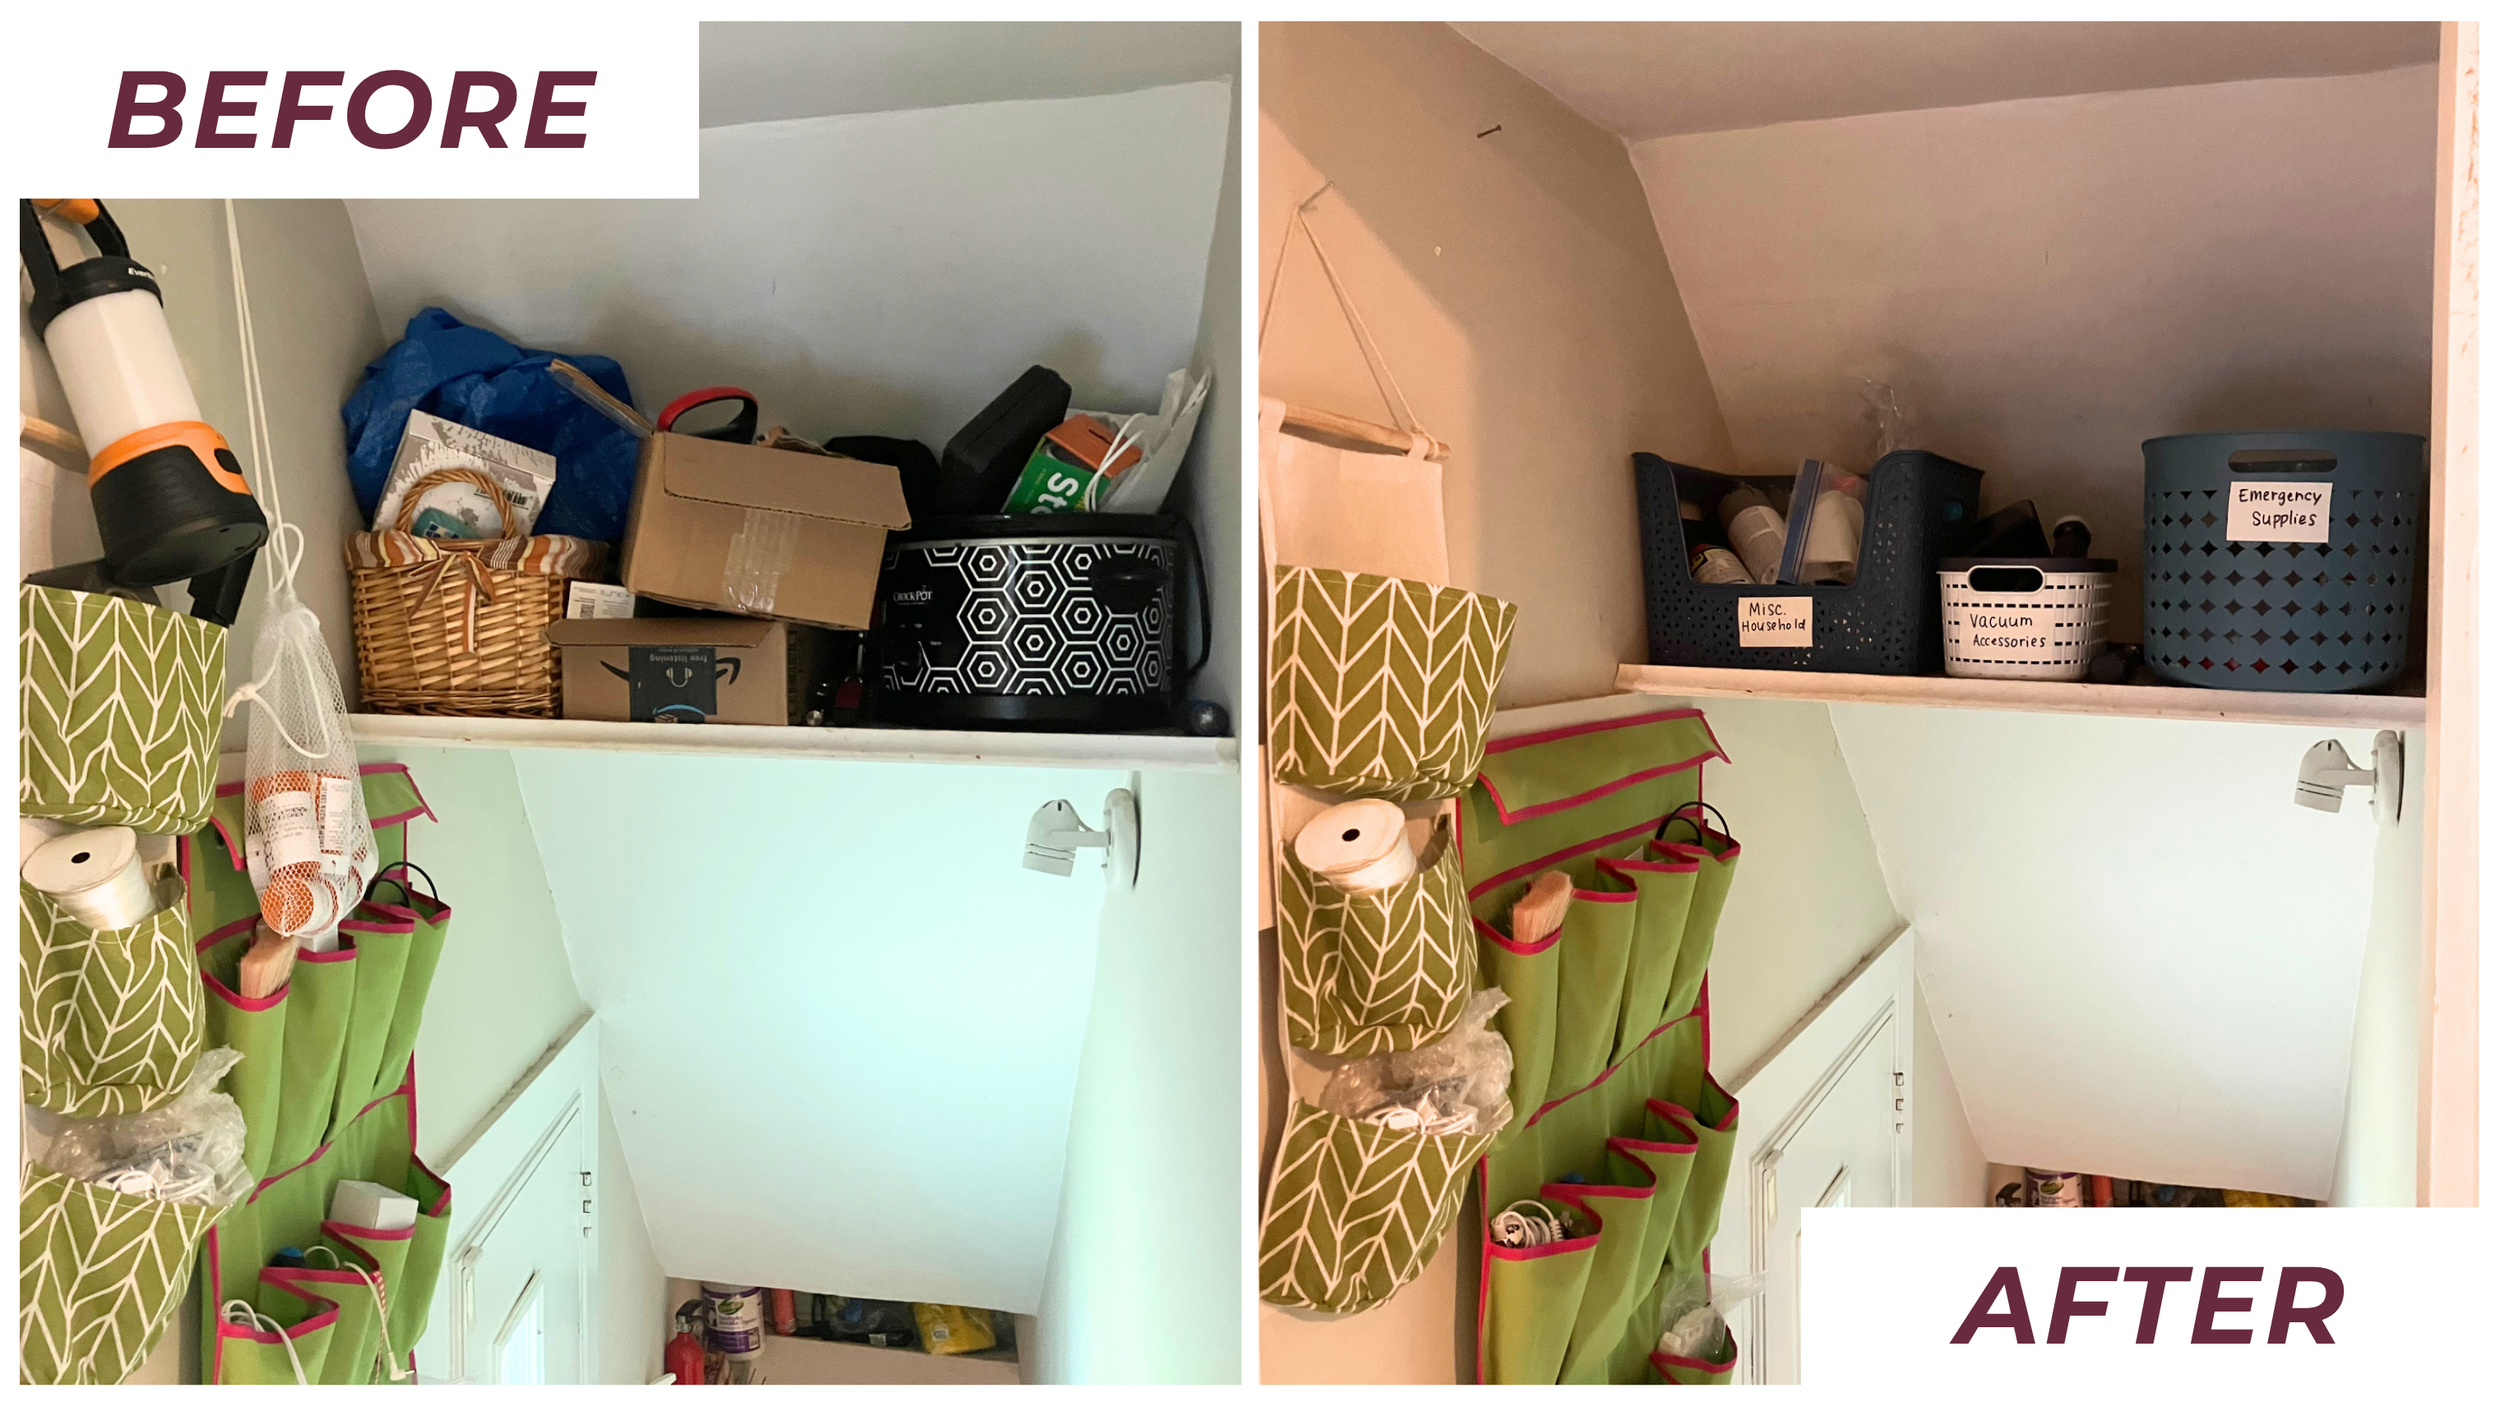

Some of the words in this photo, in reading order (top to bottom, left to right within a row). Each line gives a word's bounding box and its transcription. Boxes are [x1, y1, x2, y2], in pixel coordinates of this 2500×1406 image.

[2238, 488, 2322, 506] Emergency
[2251, 510, 2317, 529] Supplies
[1749, 602, 1787, 617] Misc.
[1741, 618, 1806, 632] Household
[1969, 613, 2033, 628] Vacuum
[1972, 633, 2047, 648] Accessories
[649, 653, 687, 664] listening
[689, 654, 708, 663] free
